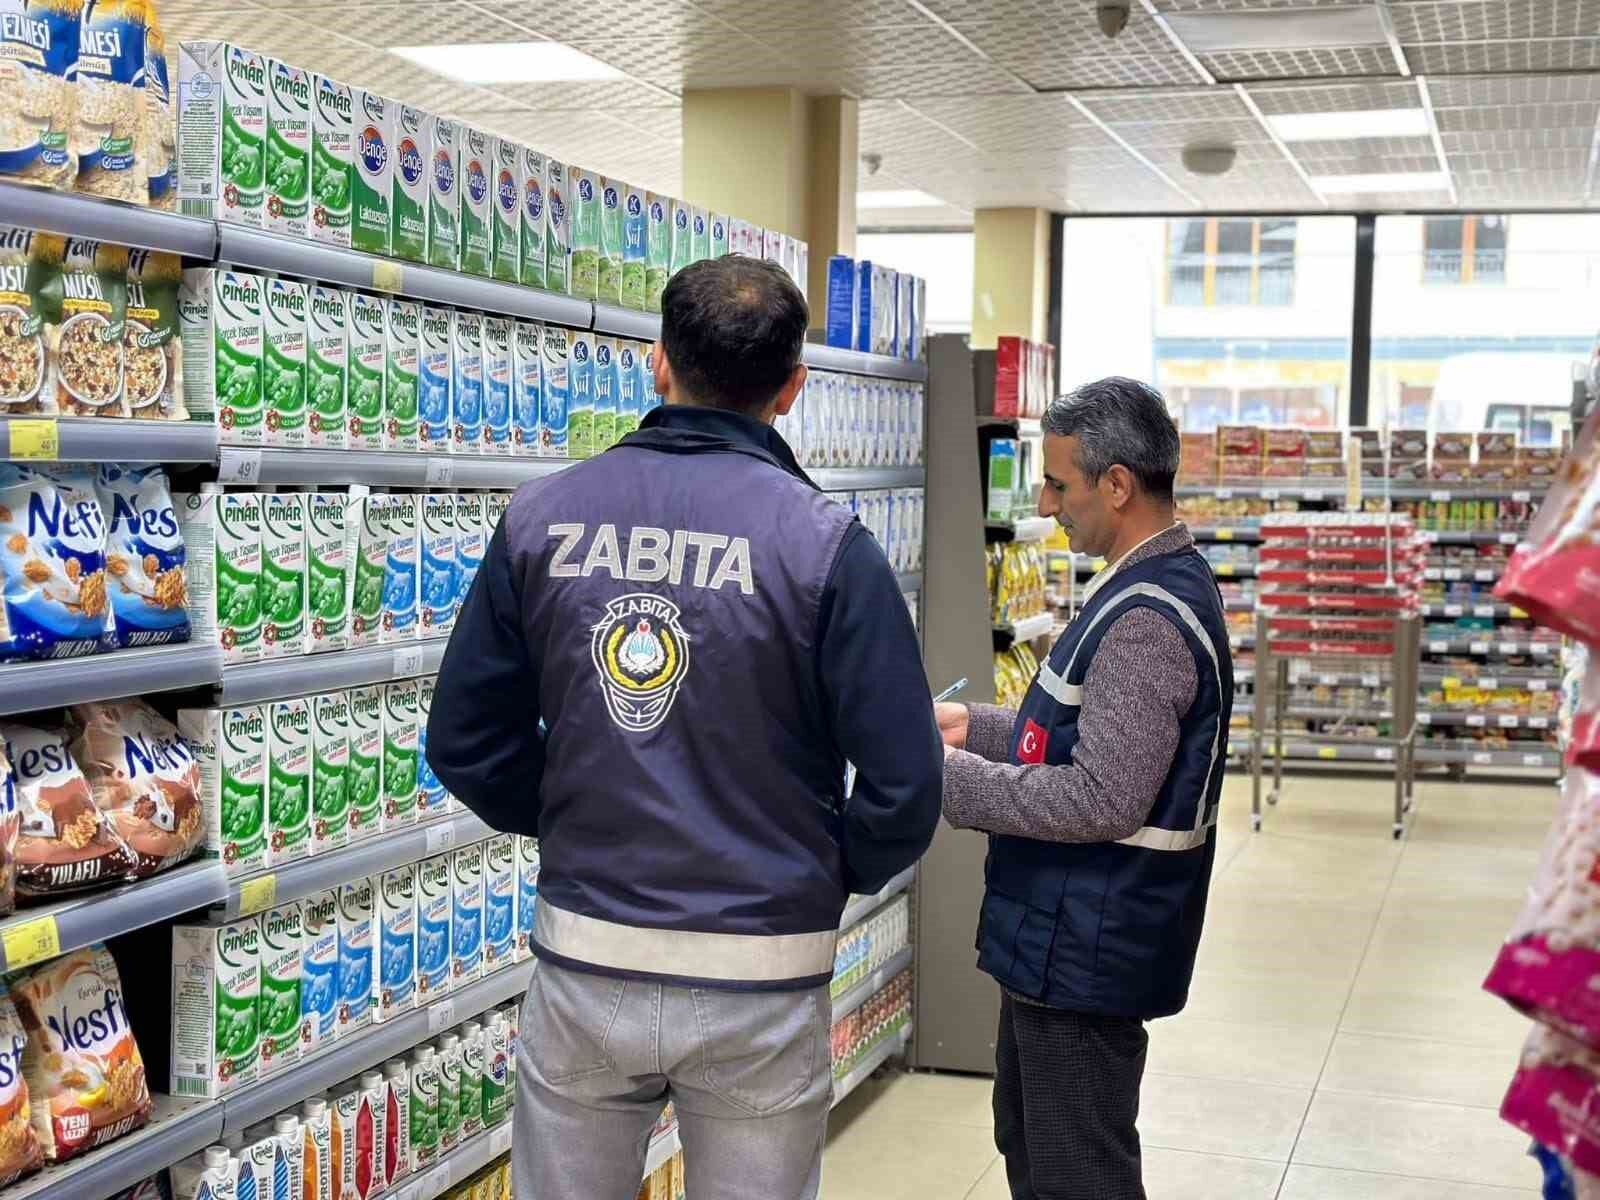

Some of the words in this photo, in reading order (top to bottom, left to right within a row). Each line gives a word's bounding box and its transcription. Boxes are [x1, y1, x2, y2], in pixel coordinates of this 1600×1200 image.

[1, 14, 50, 51] EZMESİ
[79, 28, 122, 58] MESİ
[231, 60, 264, 85] PINAR
[275, 75, 309, 99] PINAR
[319, 89, 352, 113] PINAR
[358, 135, 388, 166] Denge
[223, 283, 259, 305] PINAR
[271, 290, 304, 312] PINAR
[312, 297, 344, 317] PINAR
[354, 304, 382, 324] PINAR
[391, 310, 418, 329] PINAR
[424, 317, 448, 335] PINAR
[457, 322, 480, 339] PINAR
[485, 325, 507, 343] PINAR
[517, 331, 538, 350] PINAR
[544, 334, 567, 350] PINAR
[573, 372, 591, 398] Süt
[595, 374, 612, 400] Süt
[225, 506, 260, 522] PINAR
[269, 505, 301, 521] PINAR
[313, 505, 343, 521] PINAR
[368, 504, 390, 521] PINAR
[391, 504, 414, 519] INAR
[426, 503, 453, 518] PINAR
[457, 503, 481, 517] PINAR
[548, 523, 754, 595] ZABITA
[614, 600, 673, 623] ZABITA
[353, 697, 379, 713] PINAR
[390, 690, 417, 707] PINAR
[277, 711, 308, 729] PINAR
[319, 703, 347, 721] PINAR
[229, 718, 263, 737] PINAR
[489, 842, 512, 861] PINAR
[50, 858, 102, 886] YULAFLI
[457, 854, 480, 872] PINAR
[422, 864, 448, 883] PINAR
[386, 876, 412, 896] PINAR
[343, 887, 370, 909] PINAR
[267, 914, 300, 938] PINAR
[224, 930, 258, 954] PINAR
[344, 1128, 352, 1184] PROTEIN
